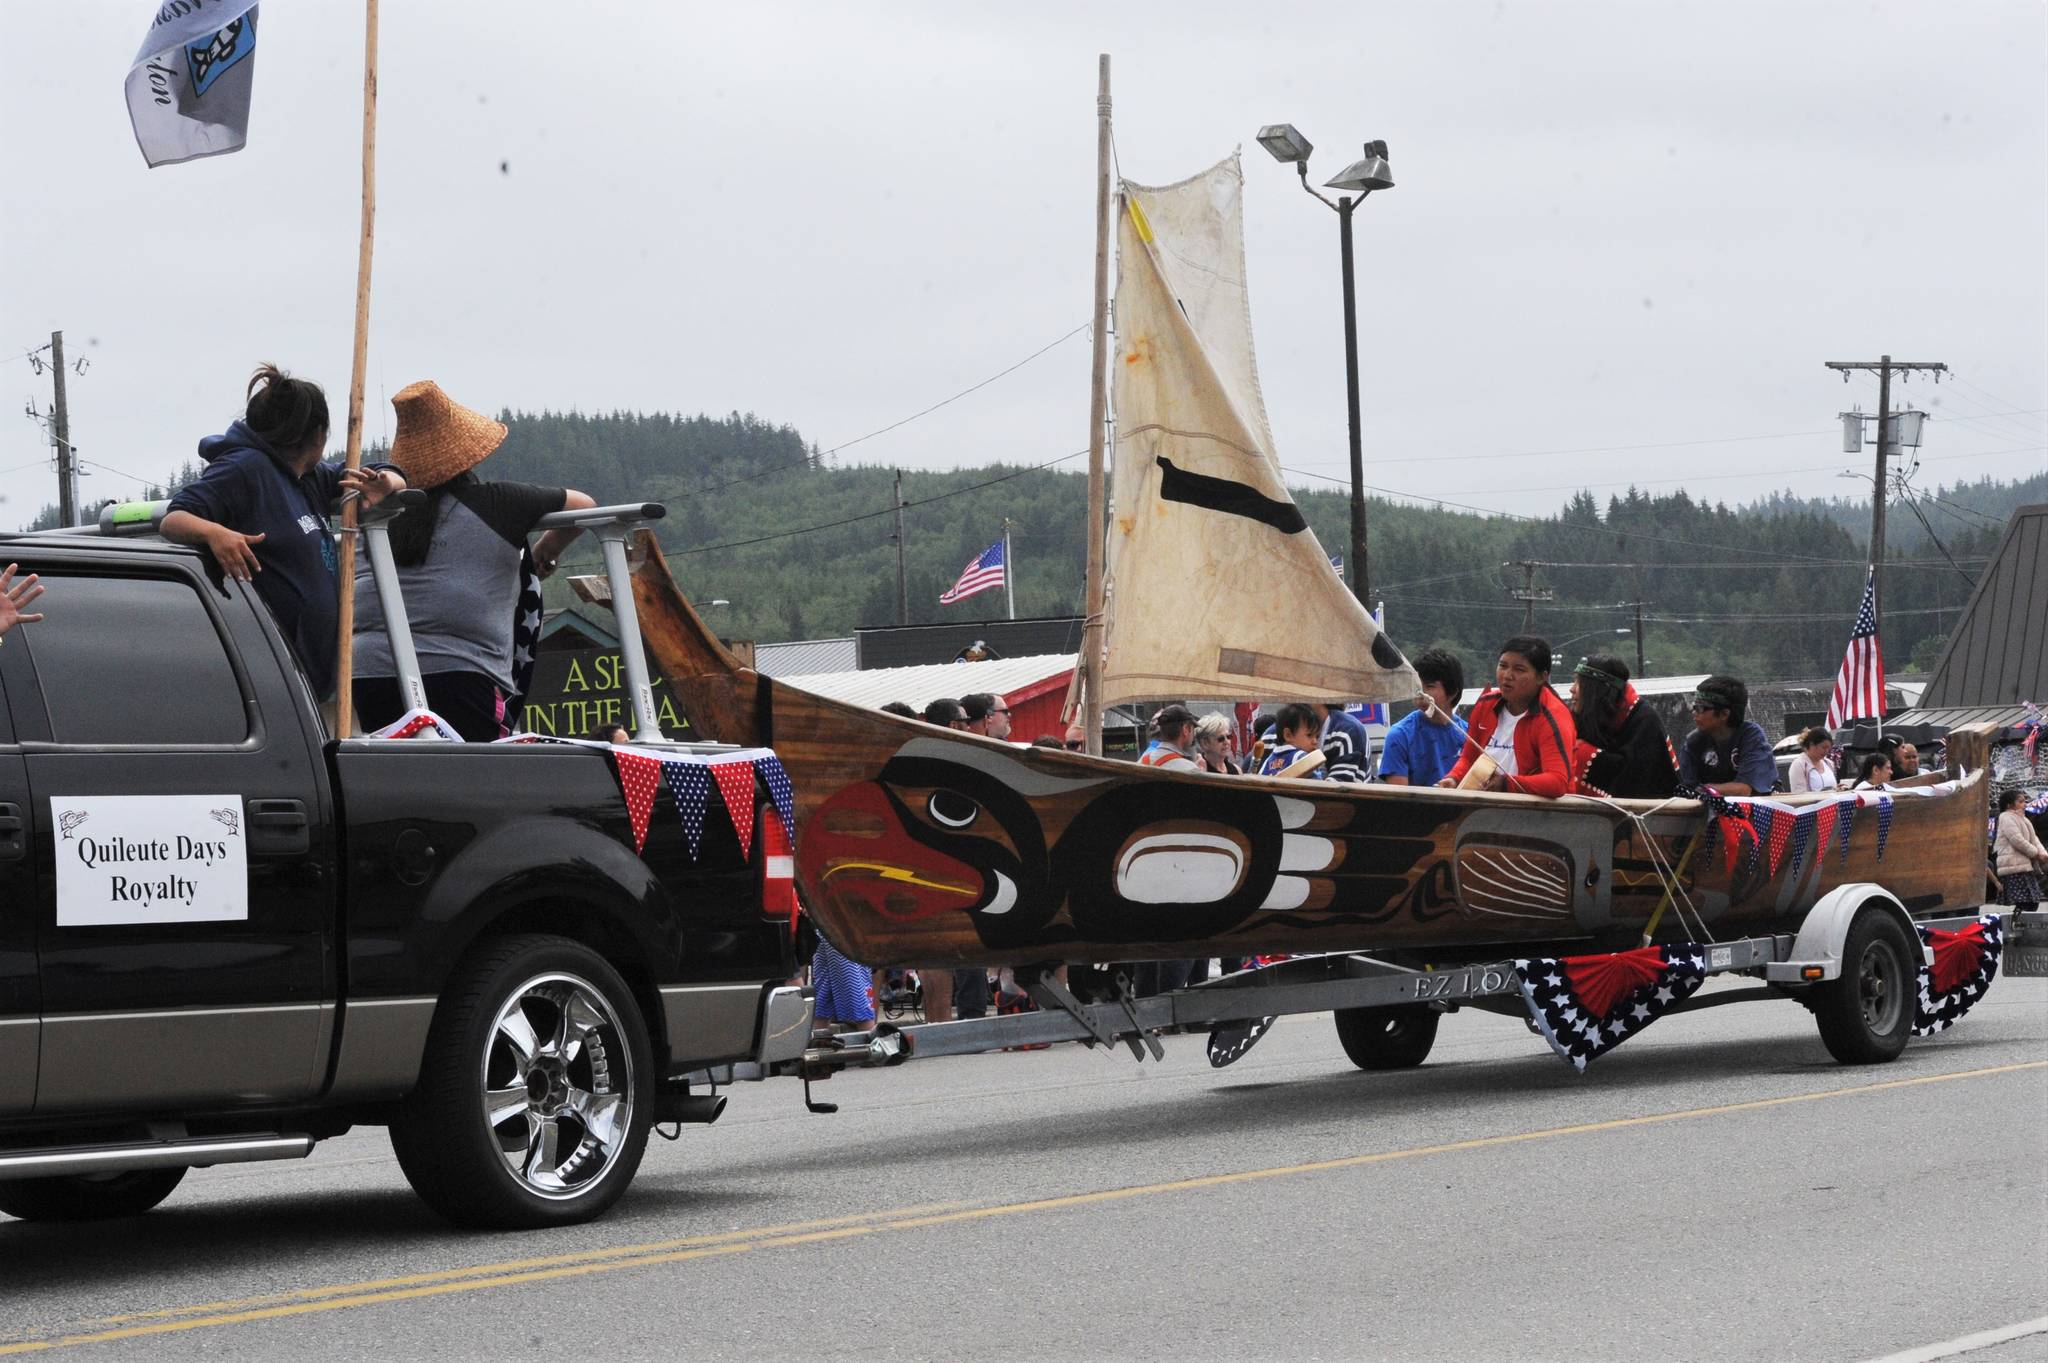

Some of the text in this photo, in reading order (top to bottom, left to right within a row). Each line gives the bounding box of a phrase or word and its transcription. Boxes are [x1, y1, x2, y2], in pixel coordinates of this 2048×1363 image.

[146, 57, 178, 106] ton
[562, 658, 590, 693] A
[524, 703, 557, 737] IN
[77, 835, 226, 869] Quileute Days
[111, 875, 198, 907] Royalty
[1414, 975, 1451, 999] EZ
